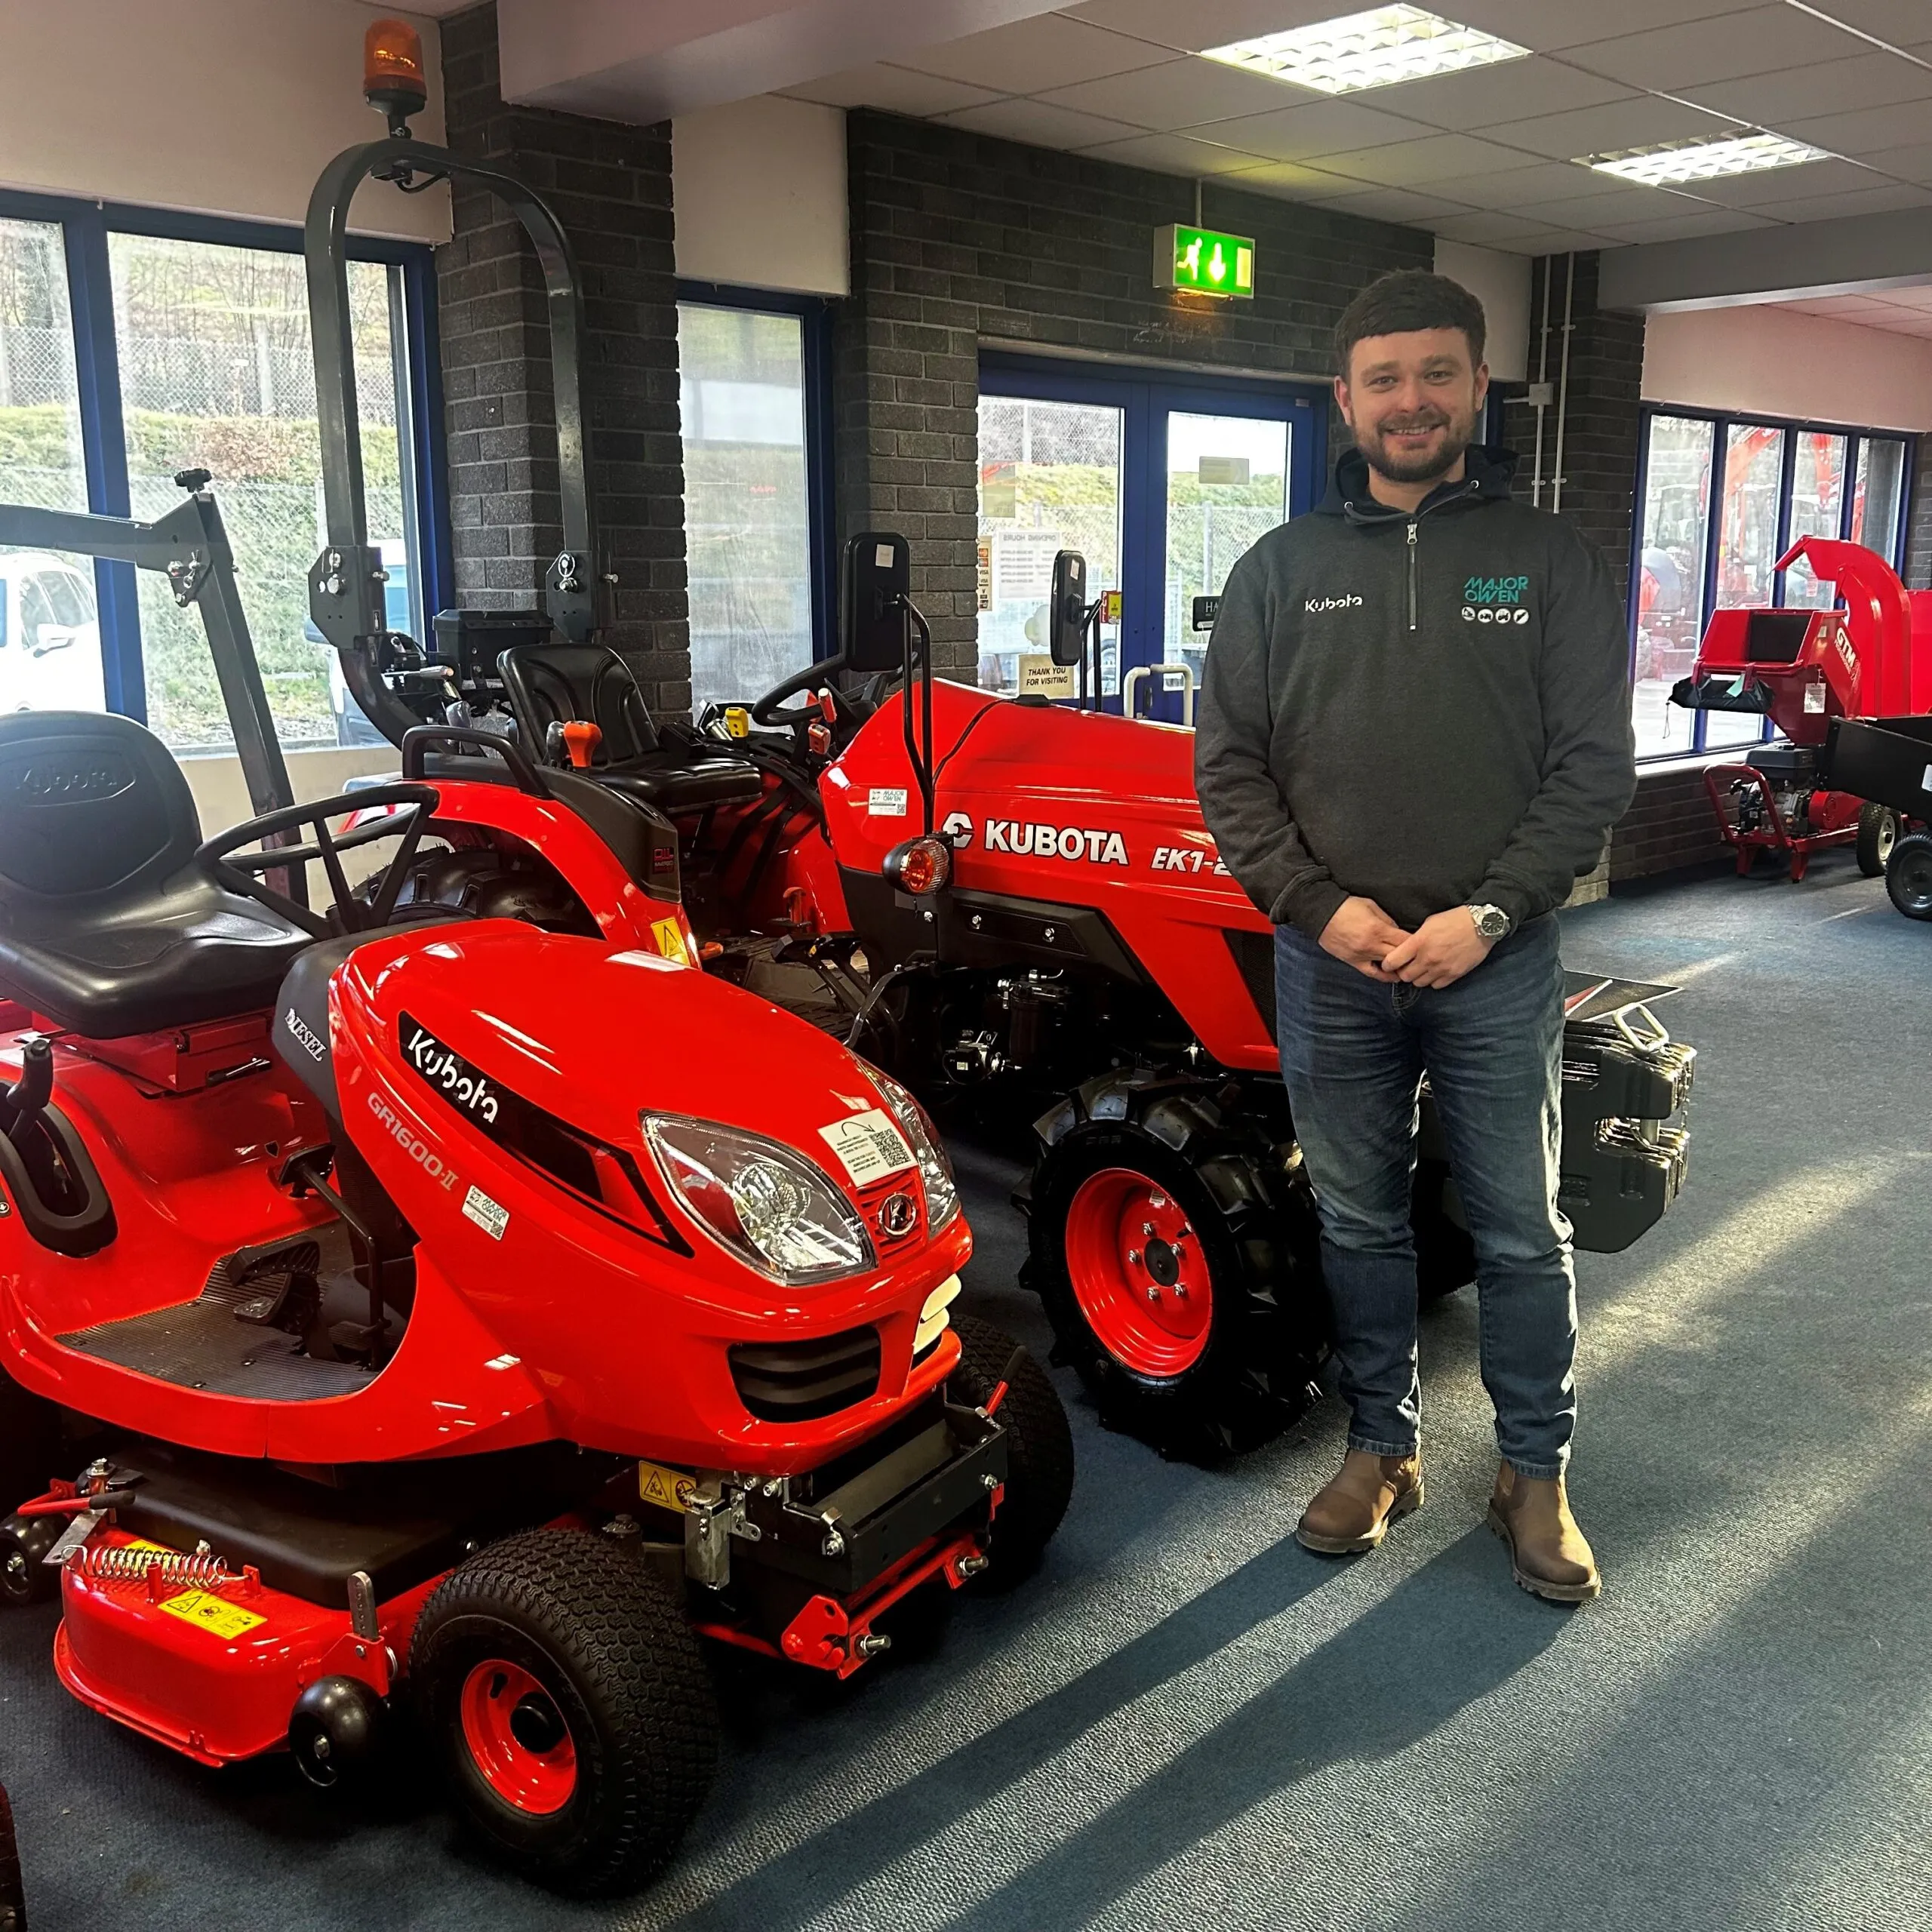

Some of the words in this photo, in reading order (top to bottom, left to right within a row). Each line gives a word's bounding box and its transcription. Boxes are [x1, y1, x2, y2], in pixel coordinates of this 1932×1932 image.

[1463, 576, 1529, 592] MAJOR
[1305, 594, 1363, 613] Kubota
[1465, 589, 1519, 604] OWEN
[1205, 601, 1220, 613] HA
[1837, 627, 1856, 668] GTM
[1028, 667, 1051, 676] THANK
[1052, 666, 1066, 675] YOU
[1026, 678, 1039, 686] FOR
[1041, 676, 1069, 685] VISITING
[984, 819, 1129, 866] KUBOTA
[1151, 846, 1233, 876] EK1-2
[285, 1008, 327, 1062] DIESEL
[408, 1029, 499, 1124] Kubota
[481, 1203, 503, 1222] OWEN
[483, 1198, 507, 1218] MAJOR
